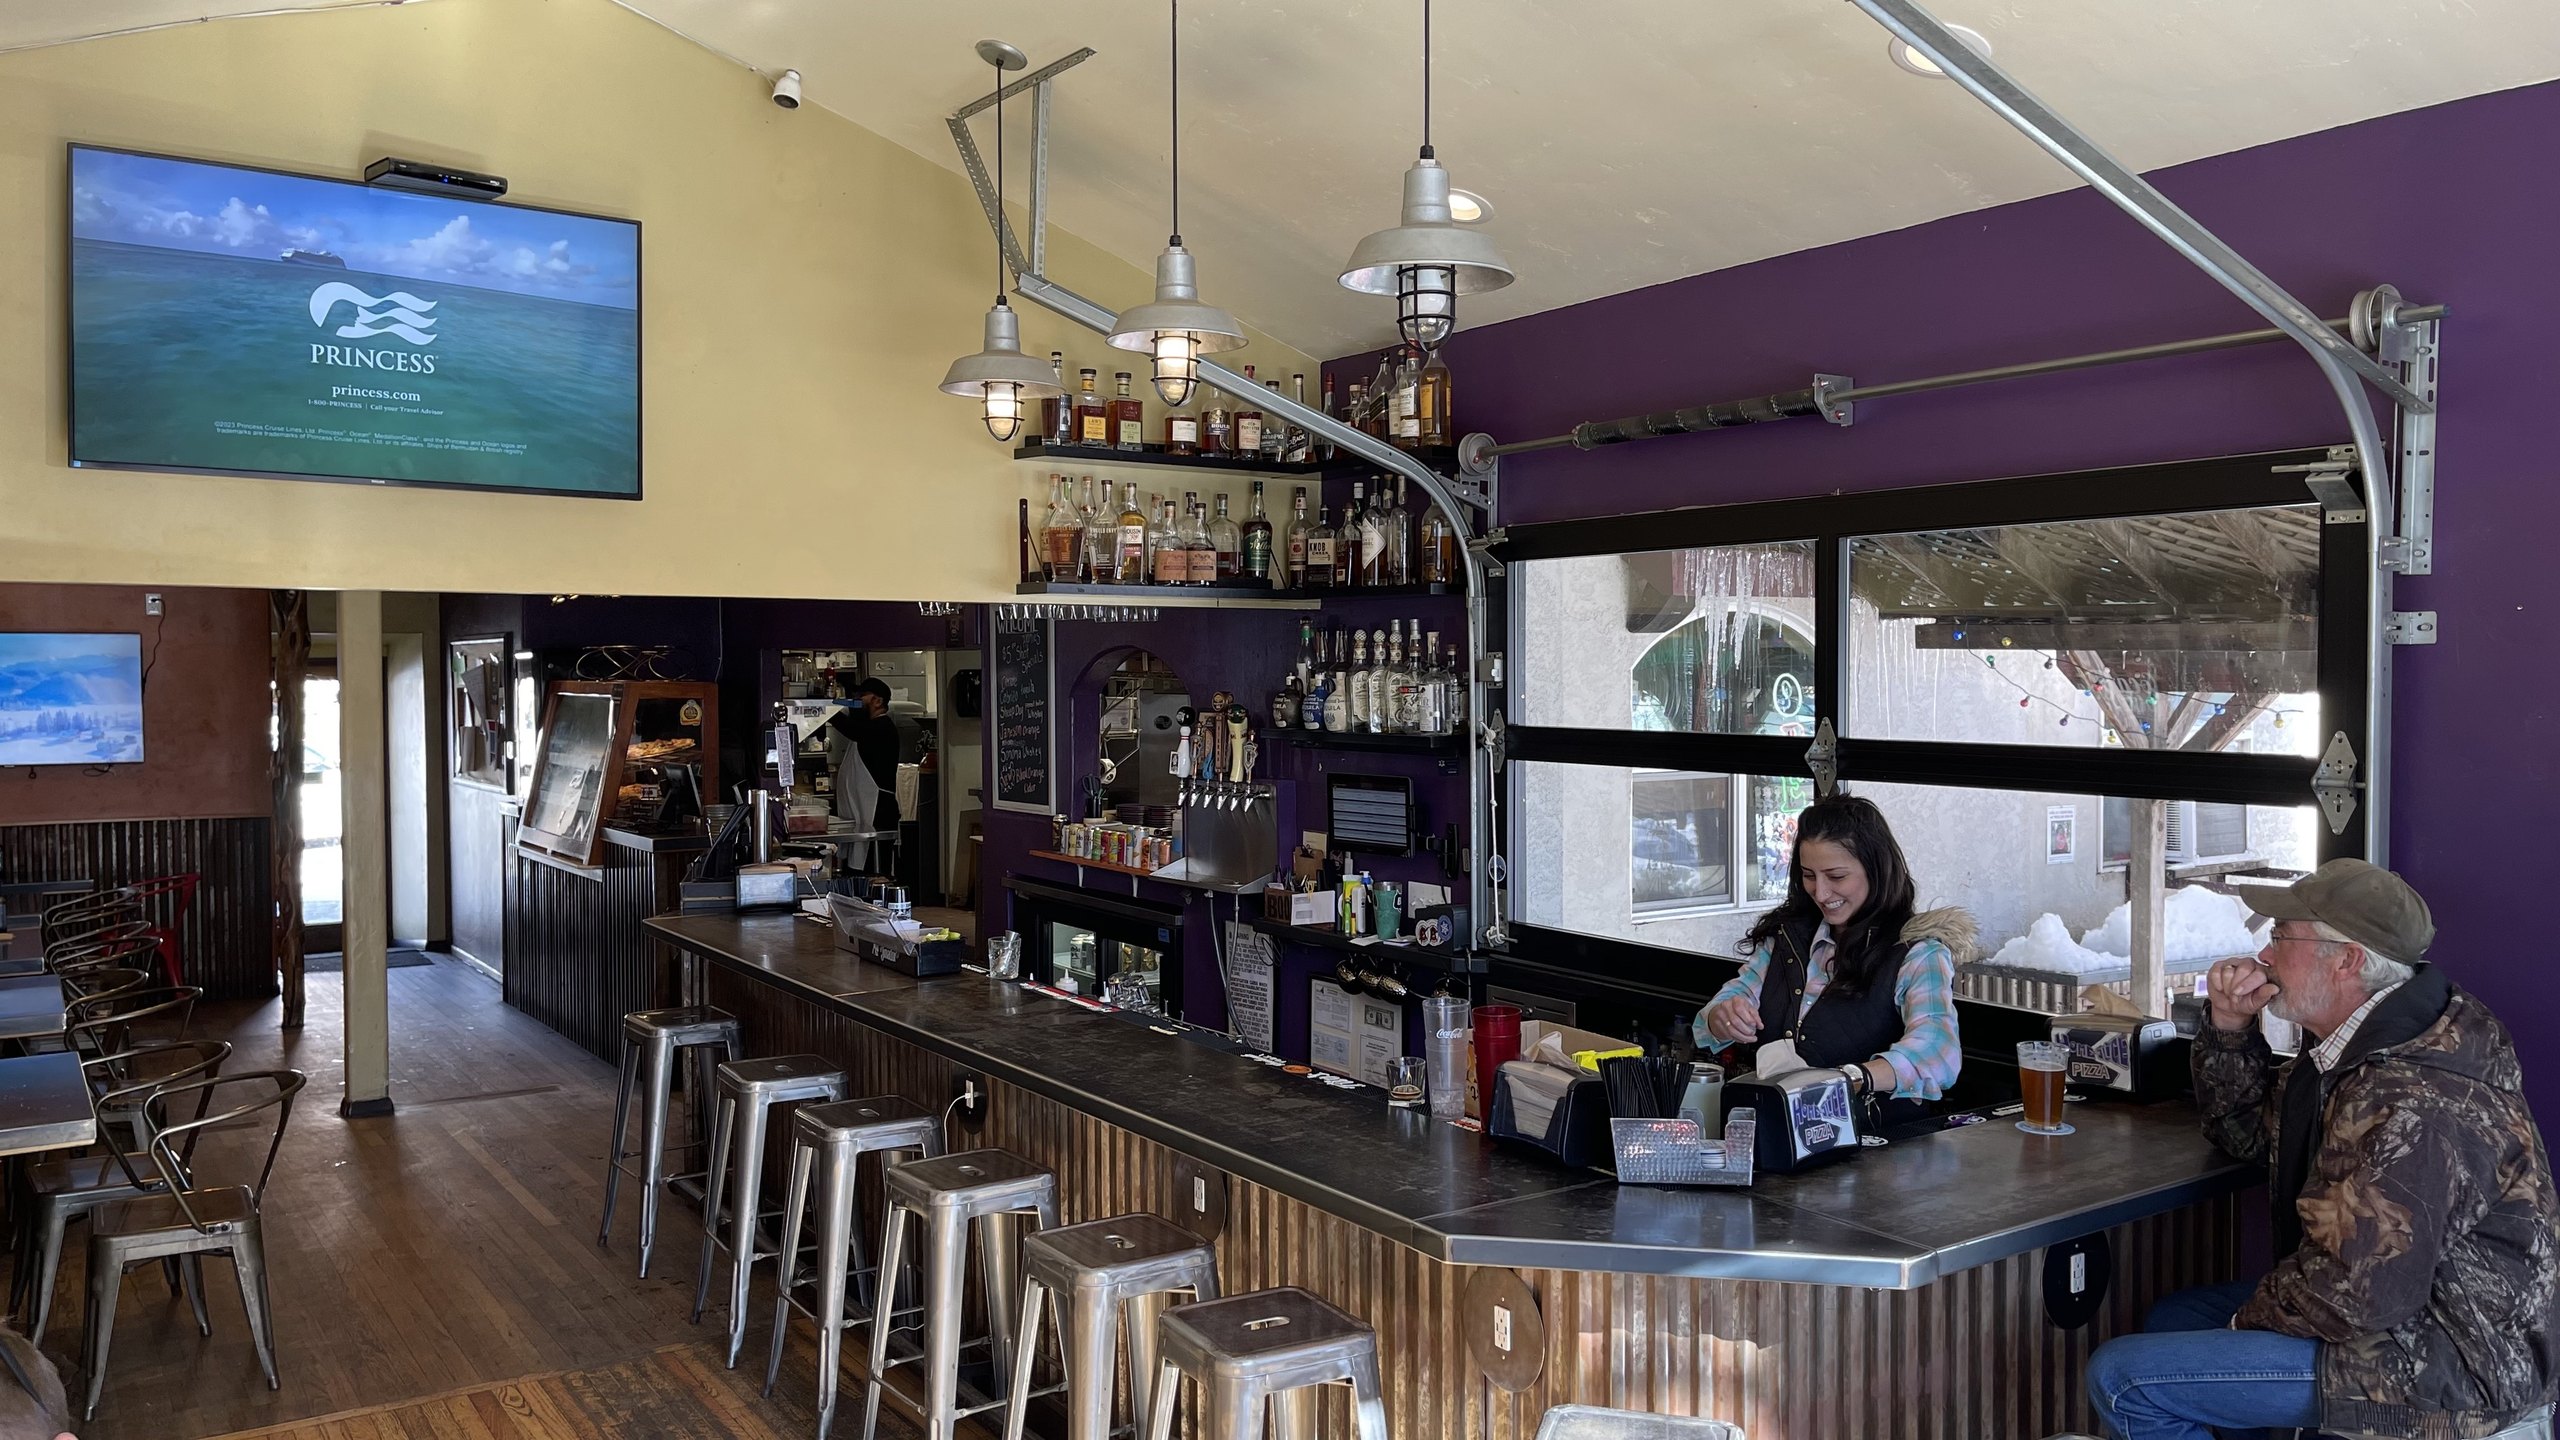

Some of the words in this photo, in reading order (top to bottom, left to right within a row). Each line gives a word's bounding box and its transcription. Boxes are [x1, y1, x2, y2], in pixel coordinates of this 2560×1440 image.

[309, 343, 436, 374] PRINCESS
[332, 384, 421, 402] princess.com
[307, 399, 363, 410] 1-800-PRINCESS
[370, 403, 383, 411] Call
[383, 405, 399, 413] your
[400, 405, 419, 414] Travel
[420, 407, 444, 416] Advisor
[1309, 542, 1326, 552] KNOB
[2071, 1061, 2110, 1080] PIZZA
[1805, 1123, 1835, 1146] PIZZA
